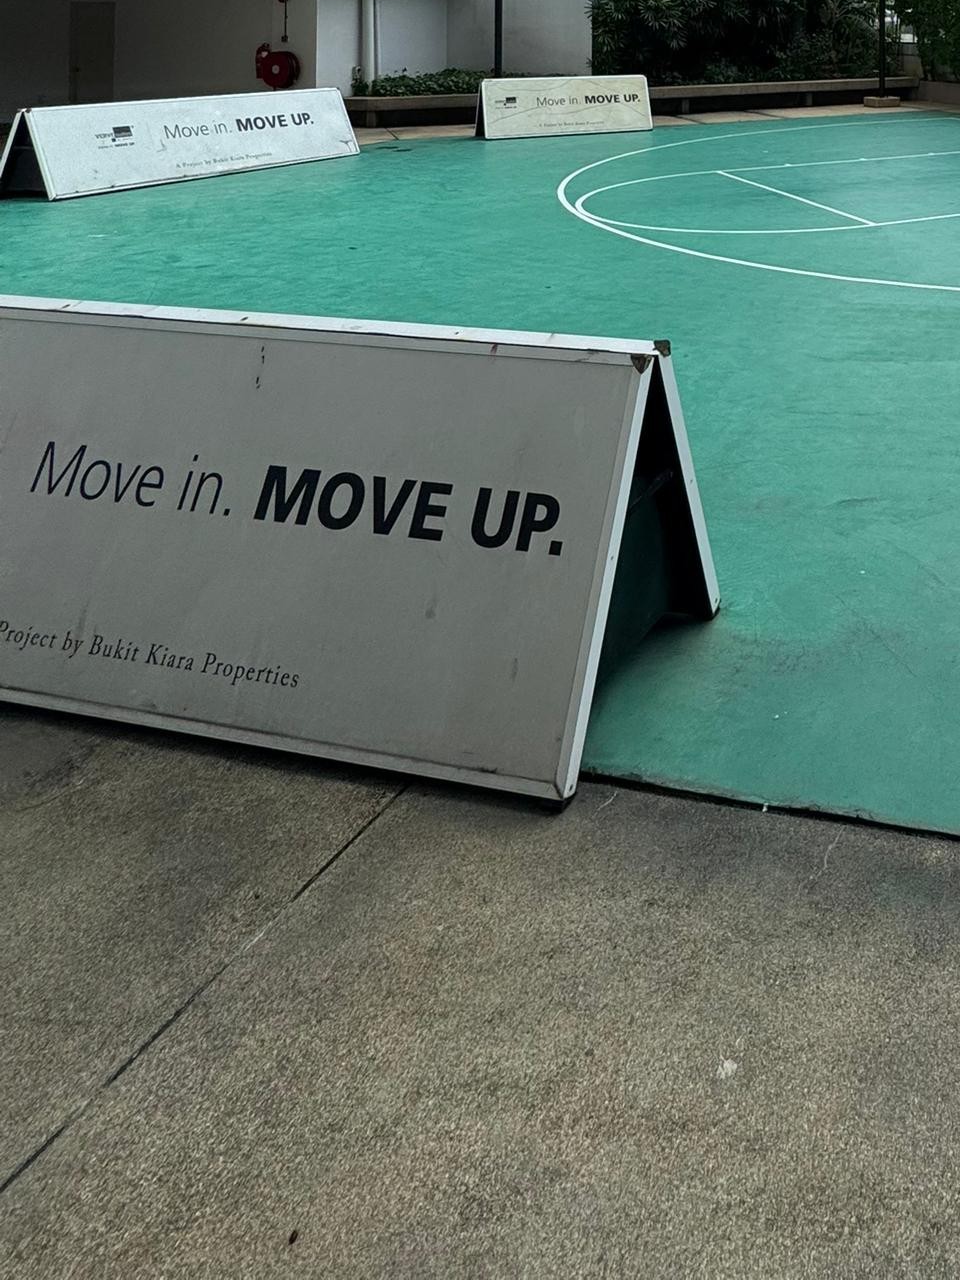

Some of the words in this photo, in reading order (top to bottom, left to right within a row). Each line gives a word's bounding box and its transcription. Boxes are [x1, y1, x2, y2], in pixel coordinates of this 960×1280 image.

[536, 96, 566, 107] Move
[585, 94, 621, 104] MOVE
[623, 93, 641, 103] UP.
[163, 124, 210, 140] Move
[214, 121, 233, 135] in.
[235, 114, 288, 132] MOVE
[291, 112, 315, 126] UP.
[30, 441, 165, 507] Move
[177, 454, 230, 516] in.
[253, 465, 453, 541] MOVE
[470, 487, 563, 556] UP.
[62, 631, 84, 659] by
[88, 634, 140, 661] Bukit
[145, 643, 194, 670] Kiara
[201, 652, 300, 688] Properties
